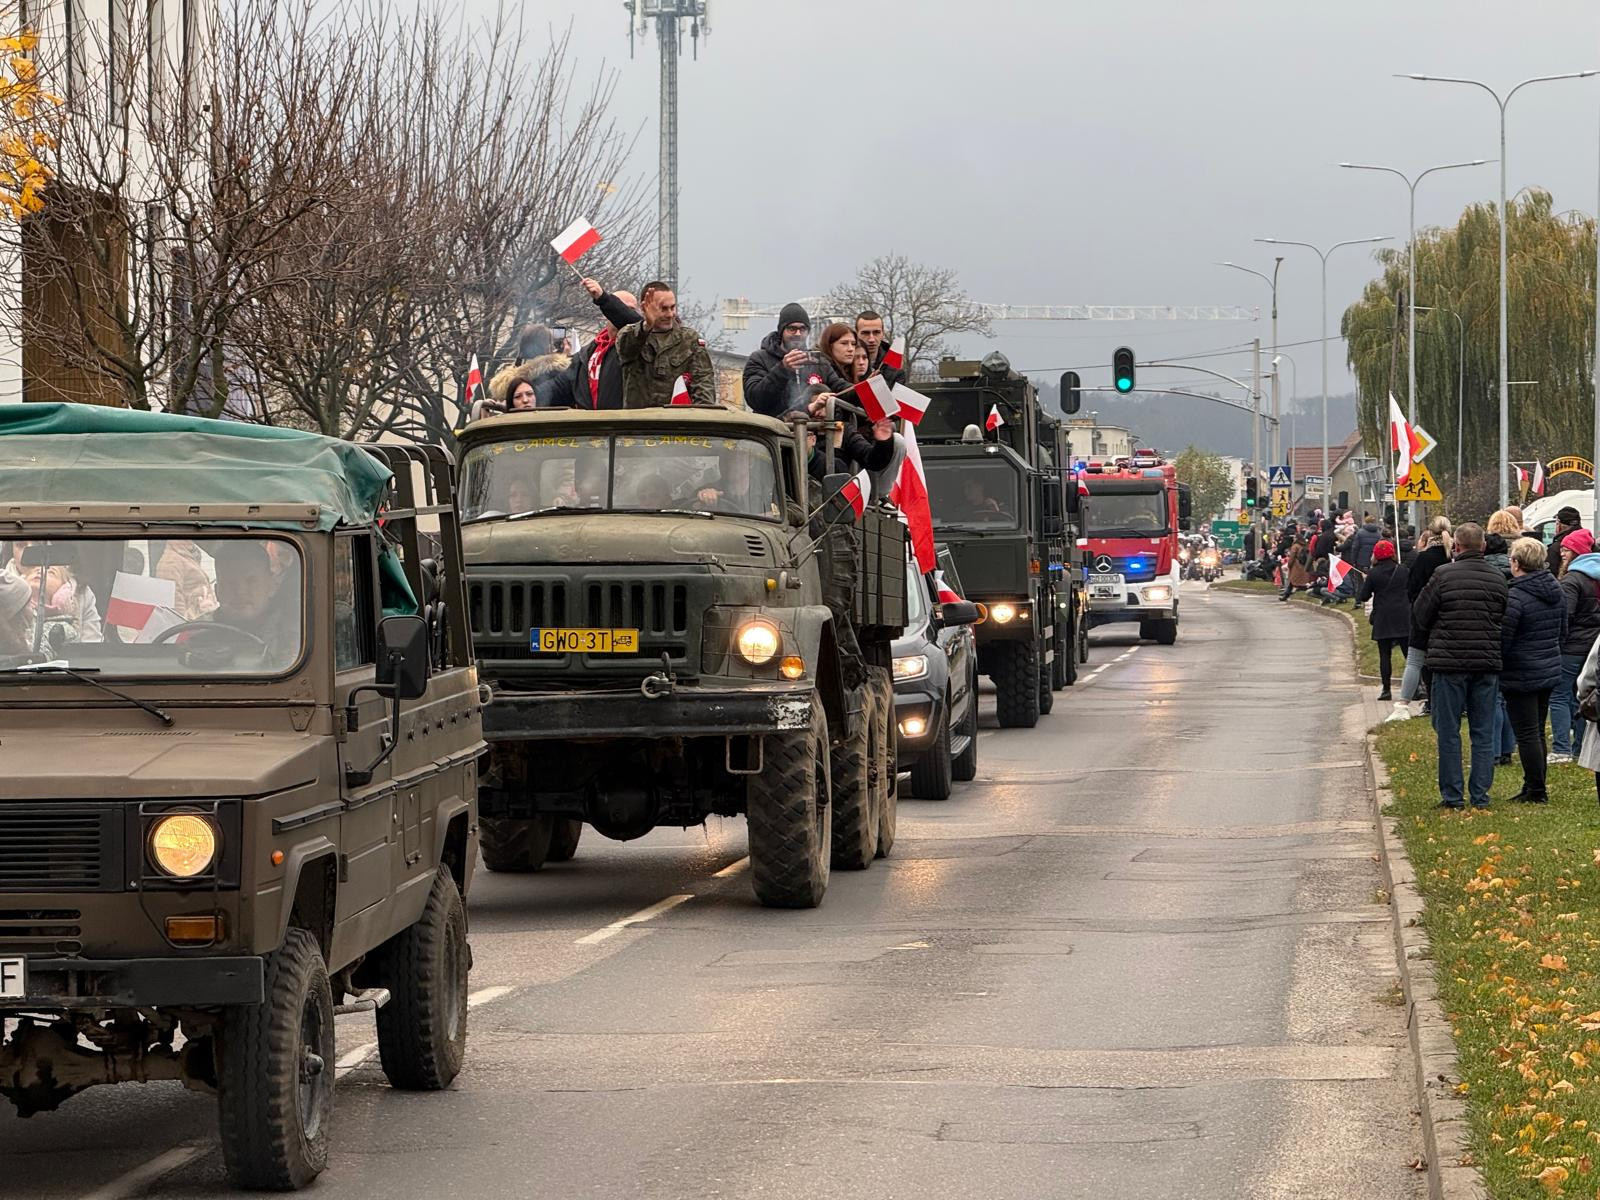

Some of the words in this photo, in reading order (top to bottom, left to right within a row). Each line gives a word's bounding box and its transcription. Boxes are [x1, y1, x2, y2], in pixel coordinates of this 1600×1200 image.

[645, 436, 712, 449] CAMEL
[543, 632, 579, 650] GWO
[586, 632, 609, 650] 3T
[1, 961, 19, 992] F
